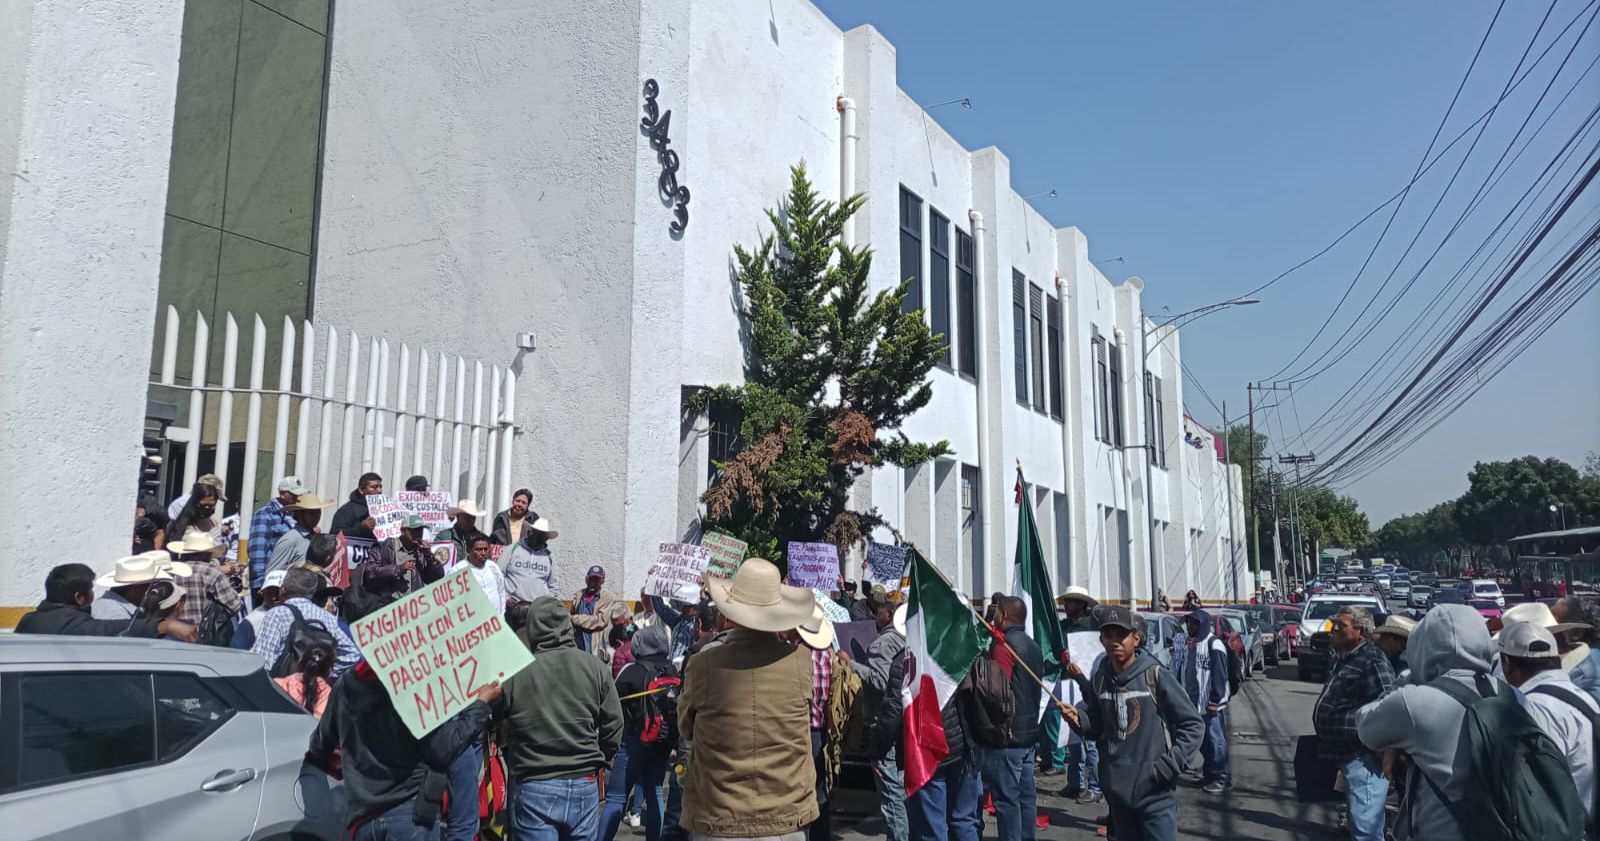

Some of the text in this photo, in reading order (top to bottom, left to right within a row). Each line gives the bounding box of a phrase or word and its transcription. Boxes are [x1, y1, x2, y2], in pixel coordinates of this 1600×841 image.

[515, 560, 548, 573] adidas
[684, 545, 697, 557] QUE
[697, 548, 710, 560] SE
[690, 560, 701, 571] EL
[356, 570, 471, 648] EXIGIMOS QUE SE
[374, 603, 476, 669] CUMPLA CON EL
[389, 653, 431, 696] PAGO
[447, 615, 502, 661] NUESTRO
